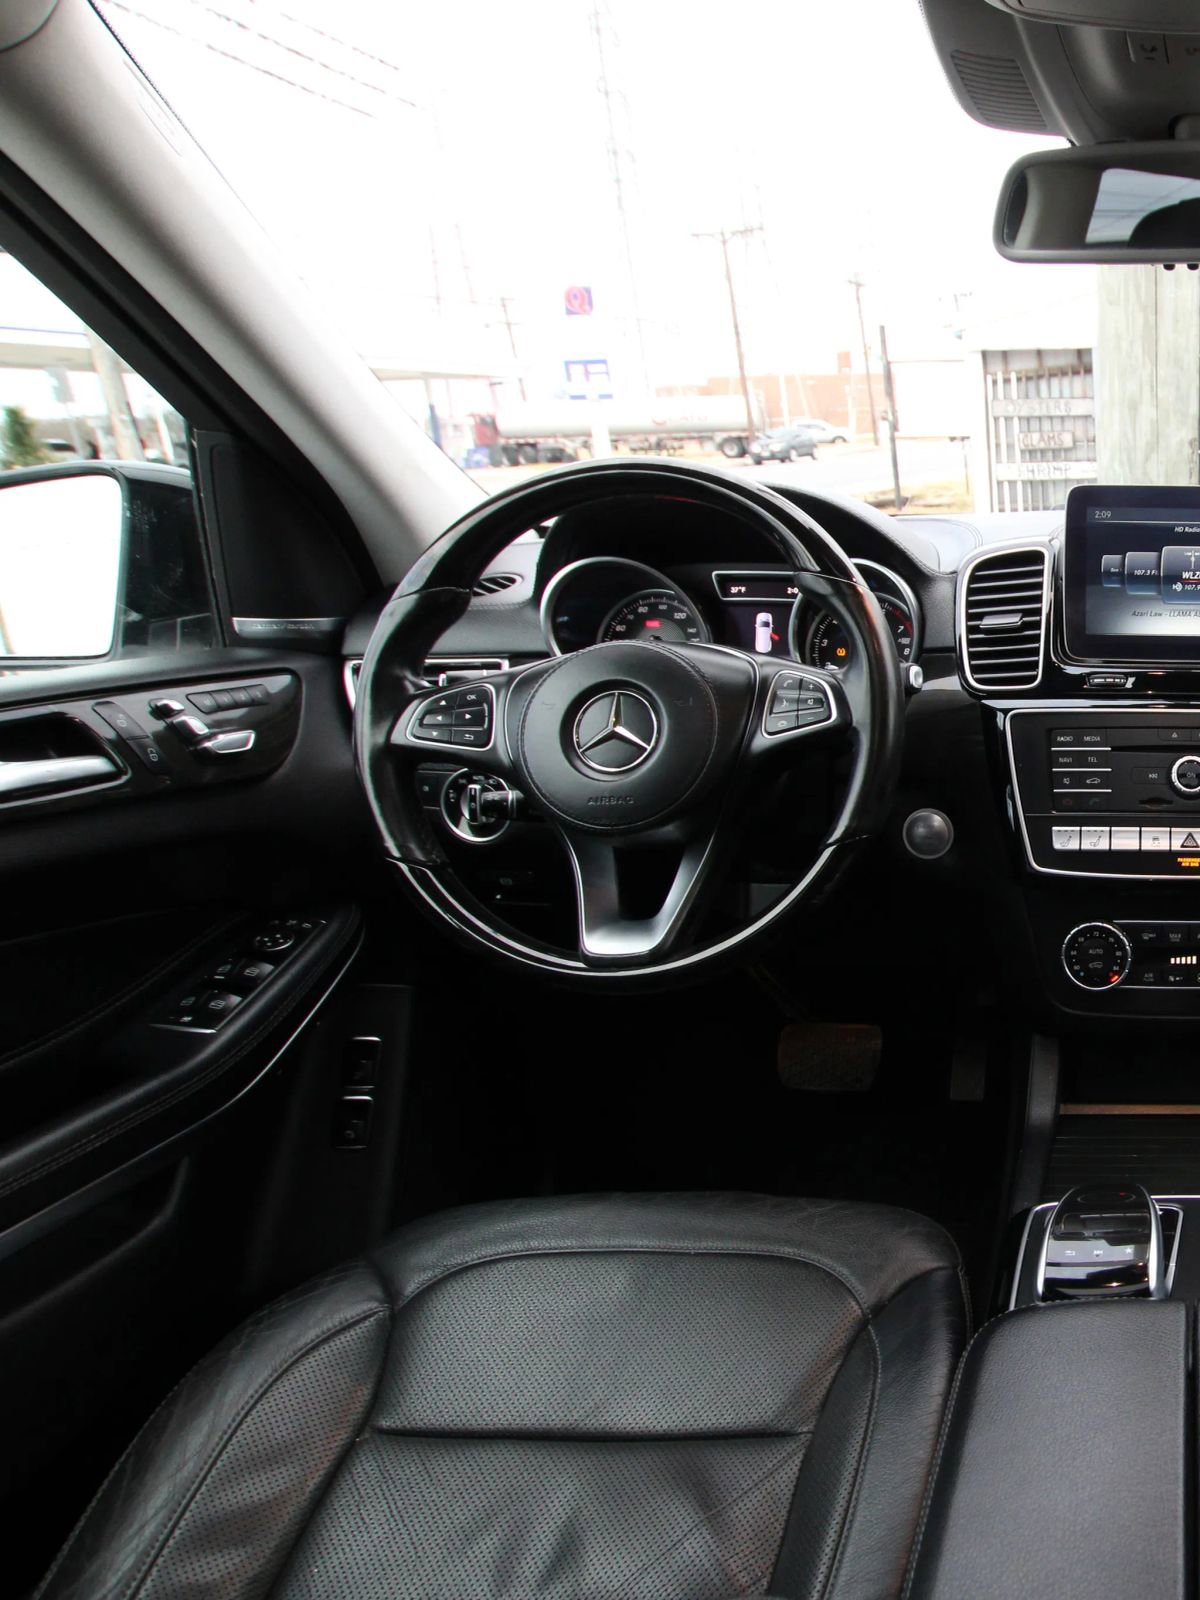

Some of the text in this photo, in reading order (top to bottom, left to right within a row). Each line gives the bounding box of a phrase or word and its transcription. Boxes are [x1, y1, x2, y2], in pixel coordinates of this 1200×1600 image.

[1022, 432, 1065, 448] CLAMS
[1094, 510, 1112, 519] 2:09
[730, 586, 746, 594] 37°F
[897, 625, 905, 633] 7
[821, 639, 828, 647] 3
[903, 647, 910, 656] 8
[587, 795, 635, 805] AIRBAG
